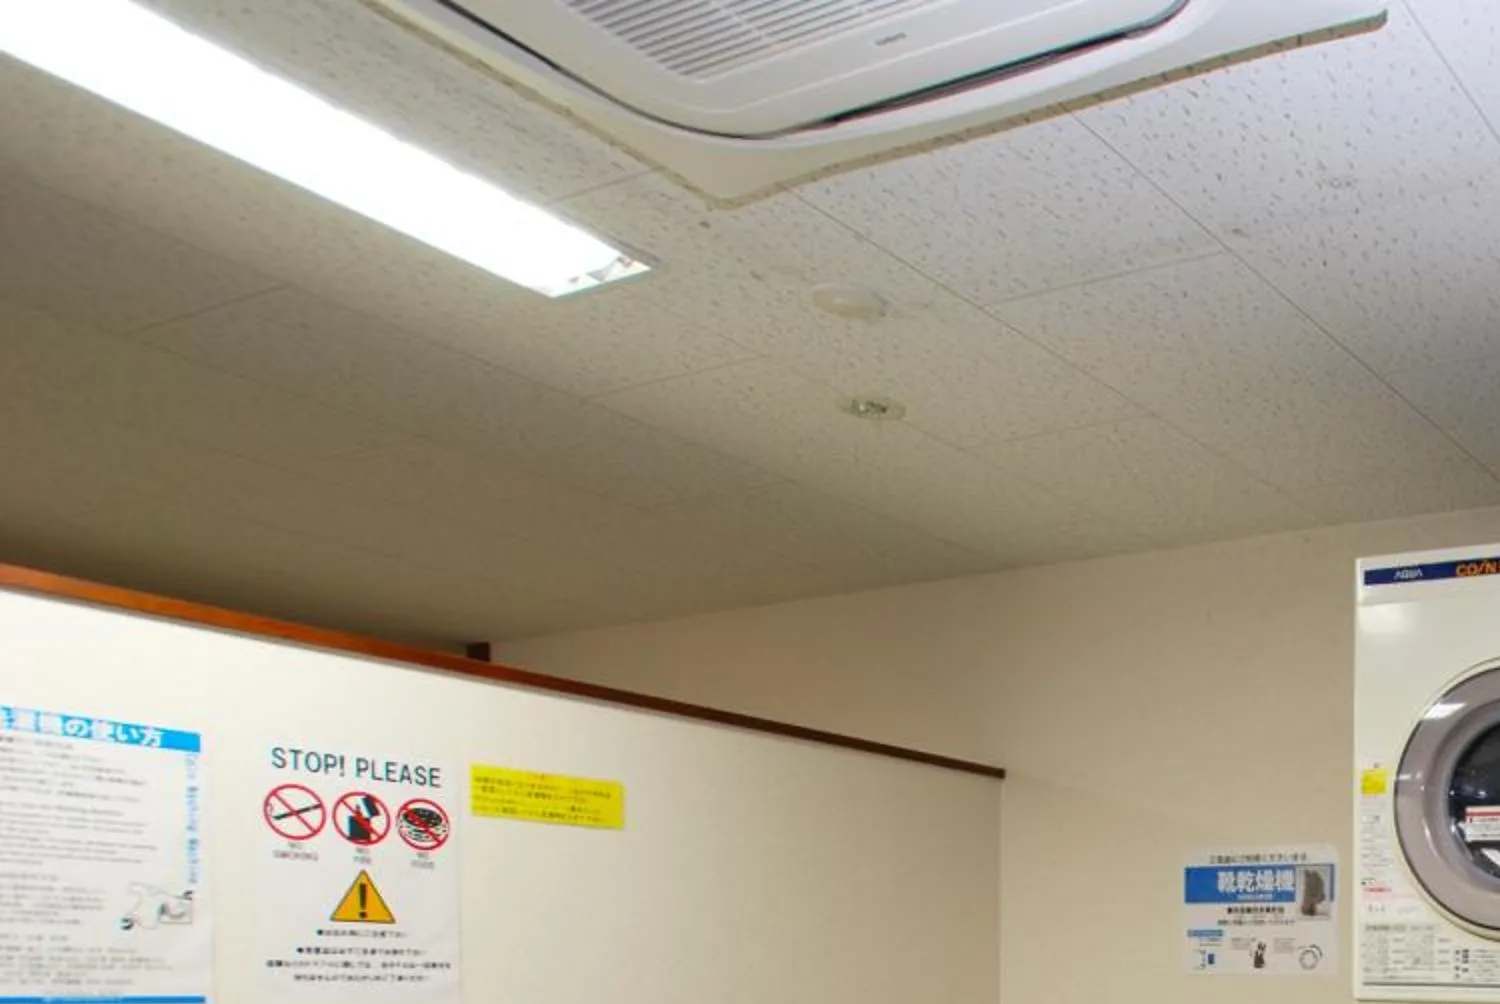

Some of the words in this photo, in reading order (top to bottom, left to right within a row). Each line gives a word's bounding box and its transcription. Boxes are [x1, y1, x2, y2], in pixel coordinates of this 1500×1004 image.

[1393, 568, 1424, 581] AQUA
[271, 747, 345, 777] STOP!
[355, 757, 442, 788] PLEASE
